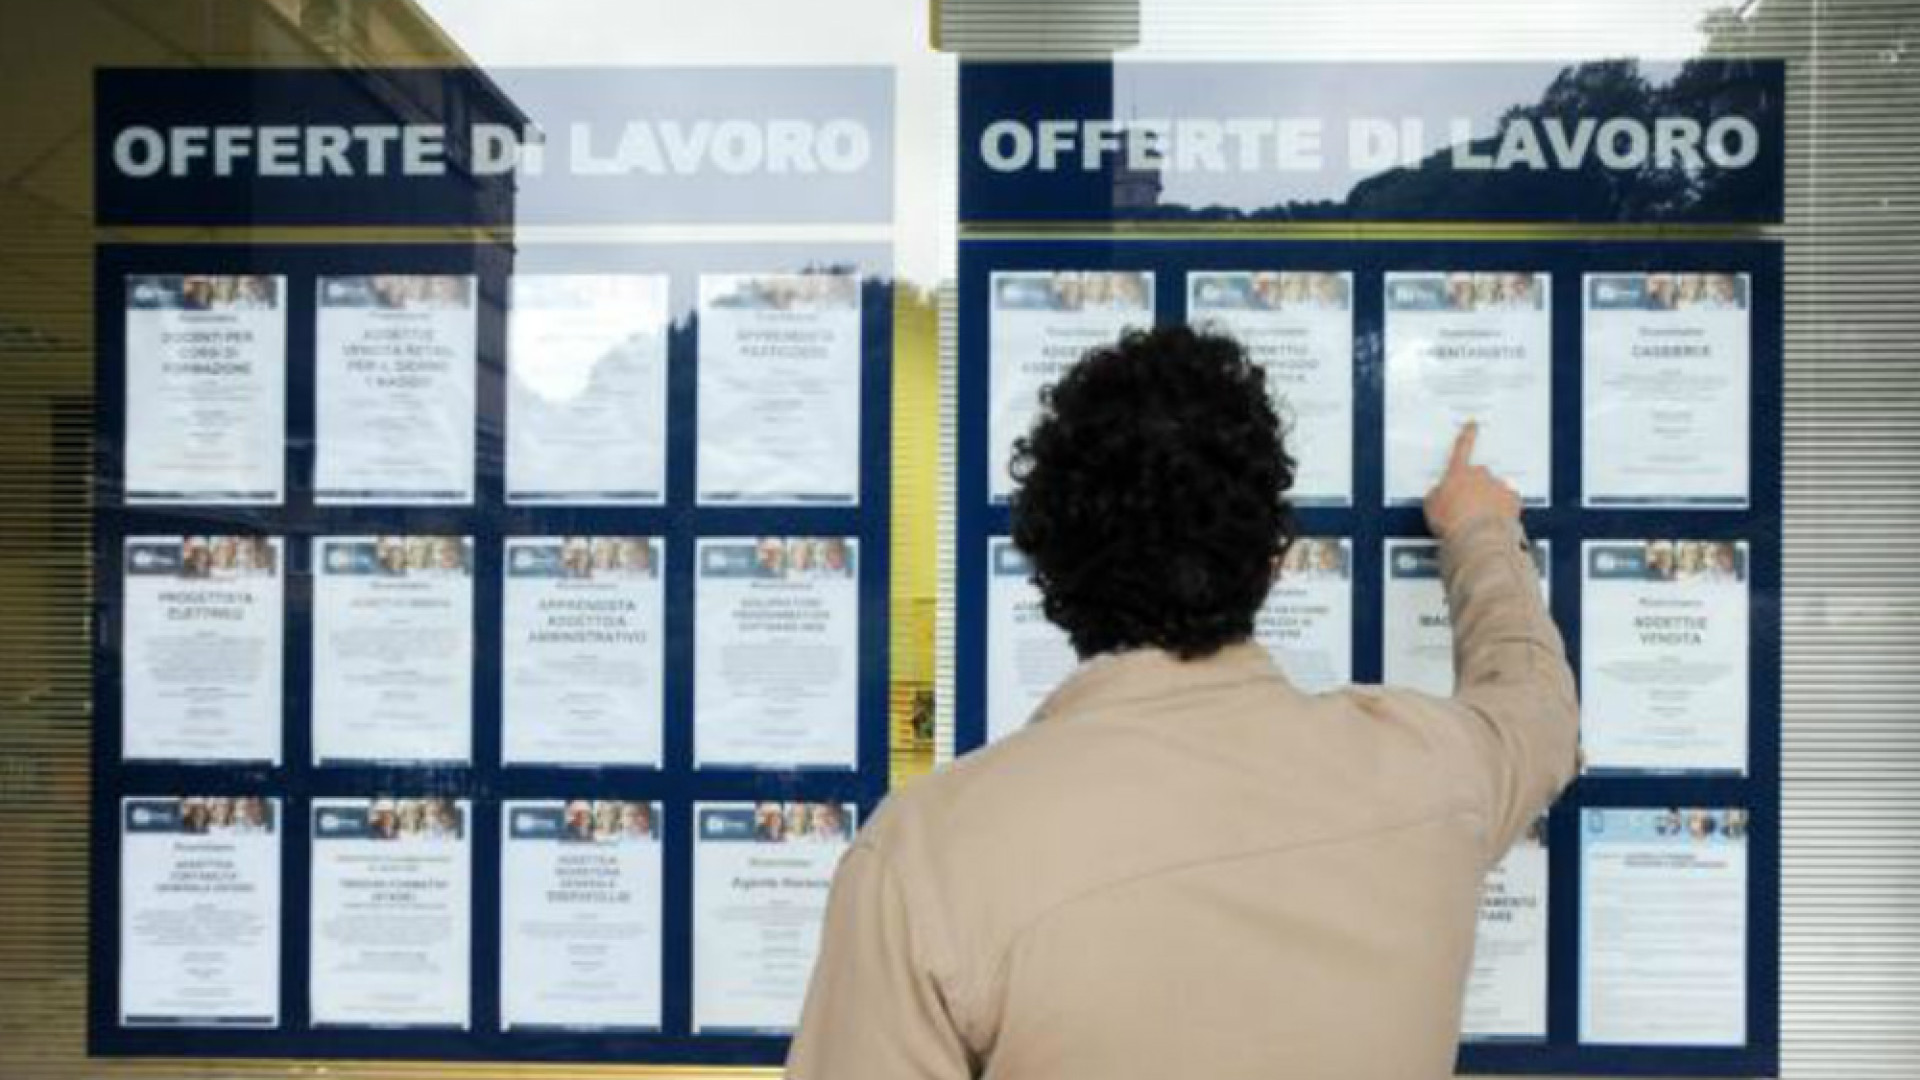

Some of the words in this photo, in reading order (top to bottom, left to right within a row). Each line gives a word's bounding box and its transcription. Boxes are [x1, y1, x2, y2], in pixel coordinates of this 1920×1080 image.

[112, 123, 446, 178] OFFERTE
[472, 123, 545, 177] DI
[569, 118, 871, 176] LAVORO
[979, 116, 1323, 172] OFFERTE
[1348, 116, 1423, 171] DI
[1450, 114, 1760, 171] LAVORO
